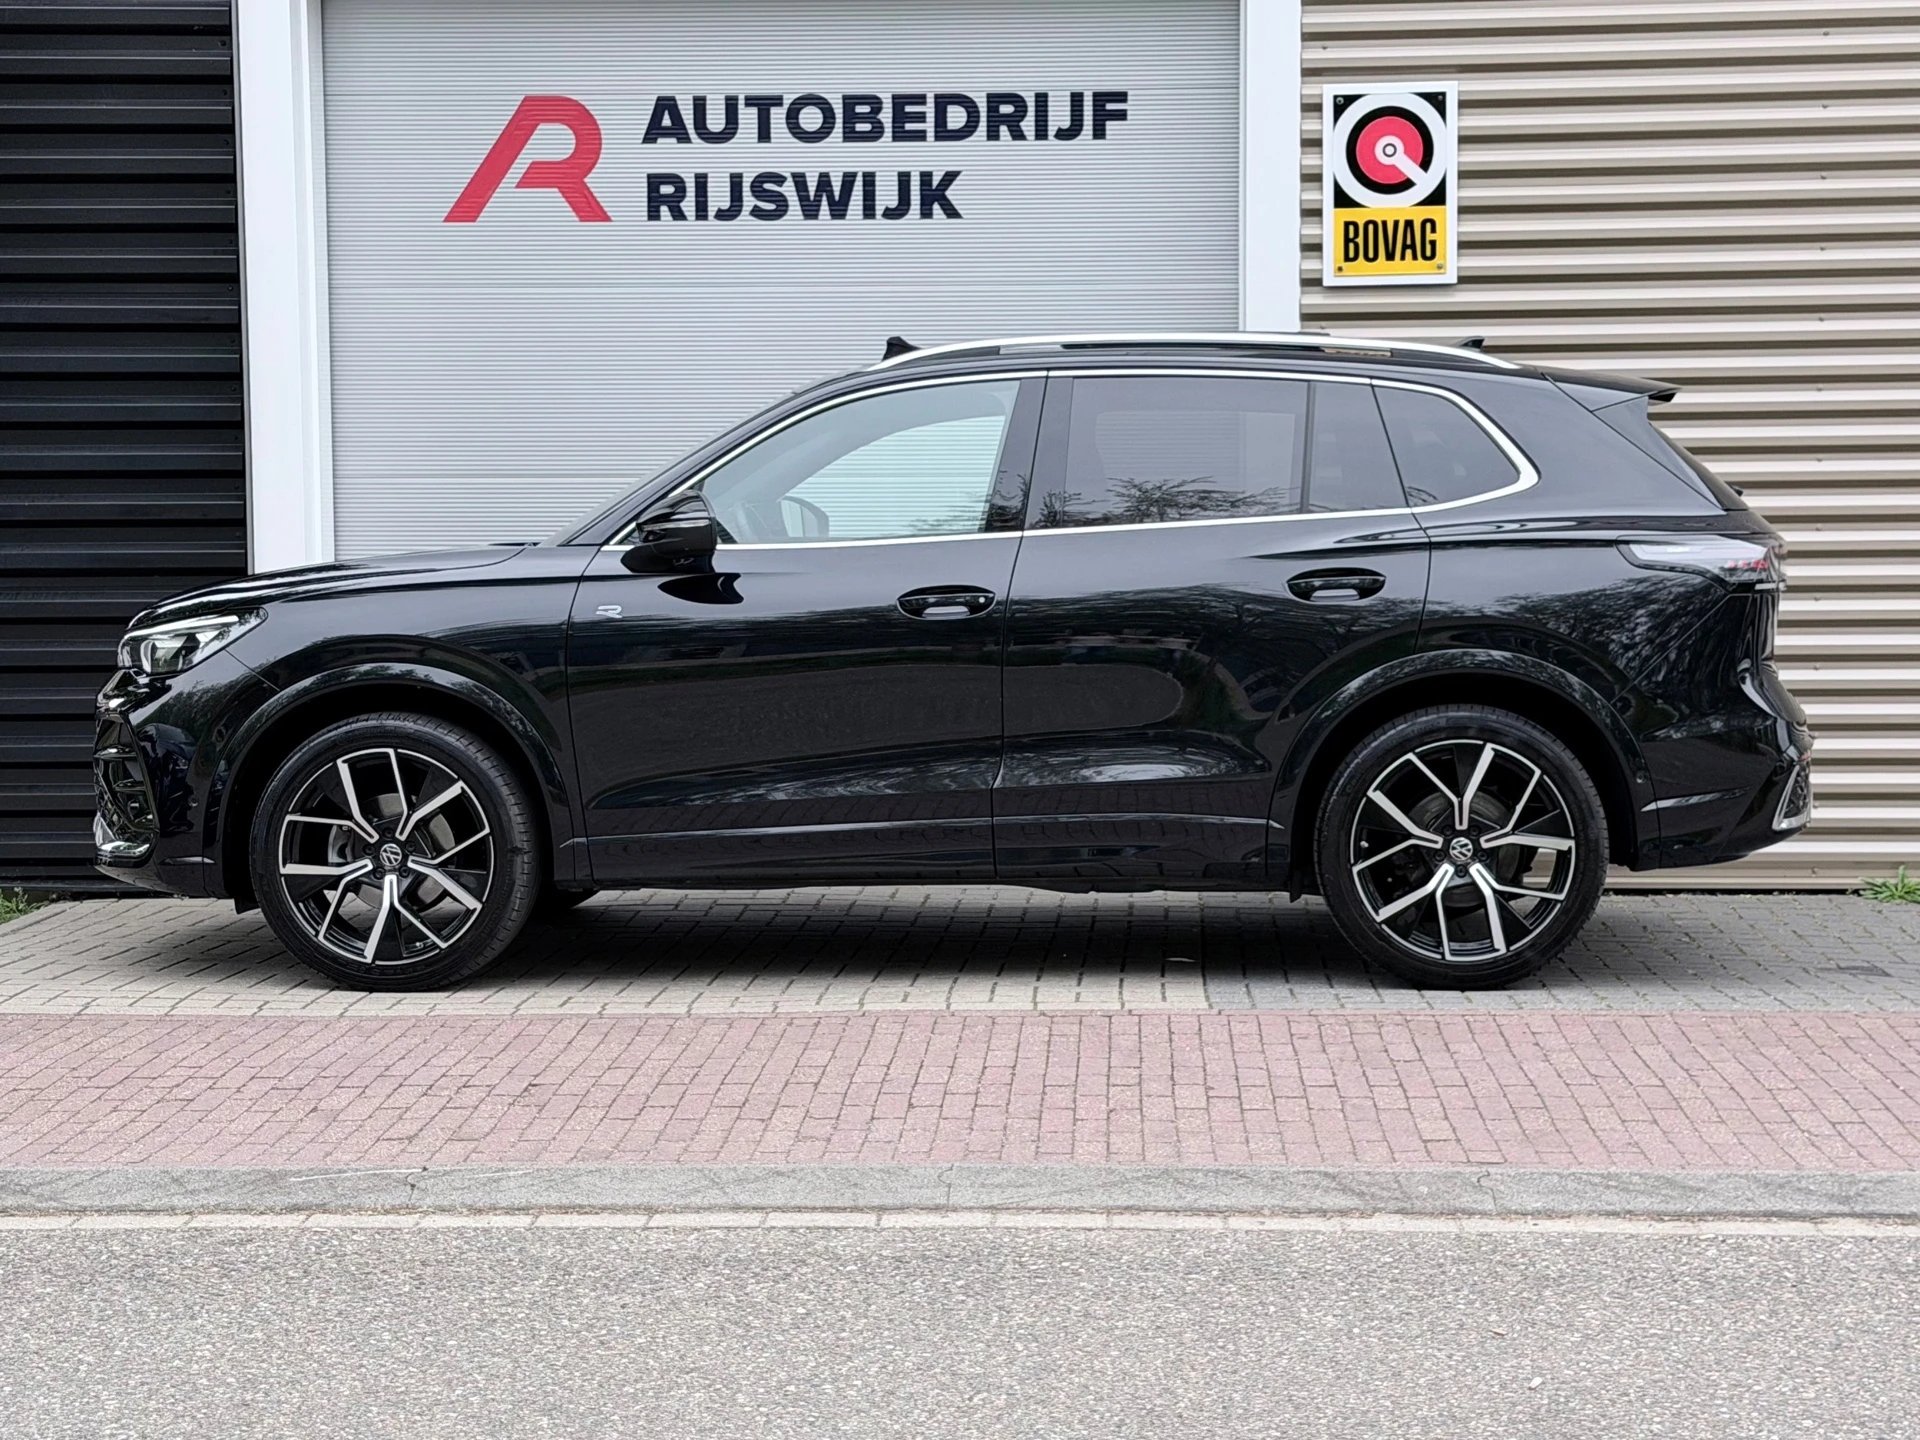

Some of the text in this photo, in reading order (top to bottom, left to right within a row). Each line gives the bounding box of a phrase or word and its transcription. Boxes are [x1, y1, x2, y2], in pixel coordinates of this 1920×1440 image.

[641, 91, 1129, 145] AUTOBEDRIJF
[646, 170, 963, 222] RIJSWIJK
[1343, 217, 1437, 263] BOVAG
